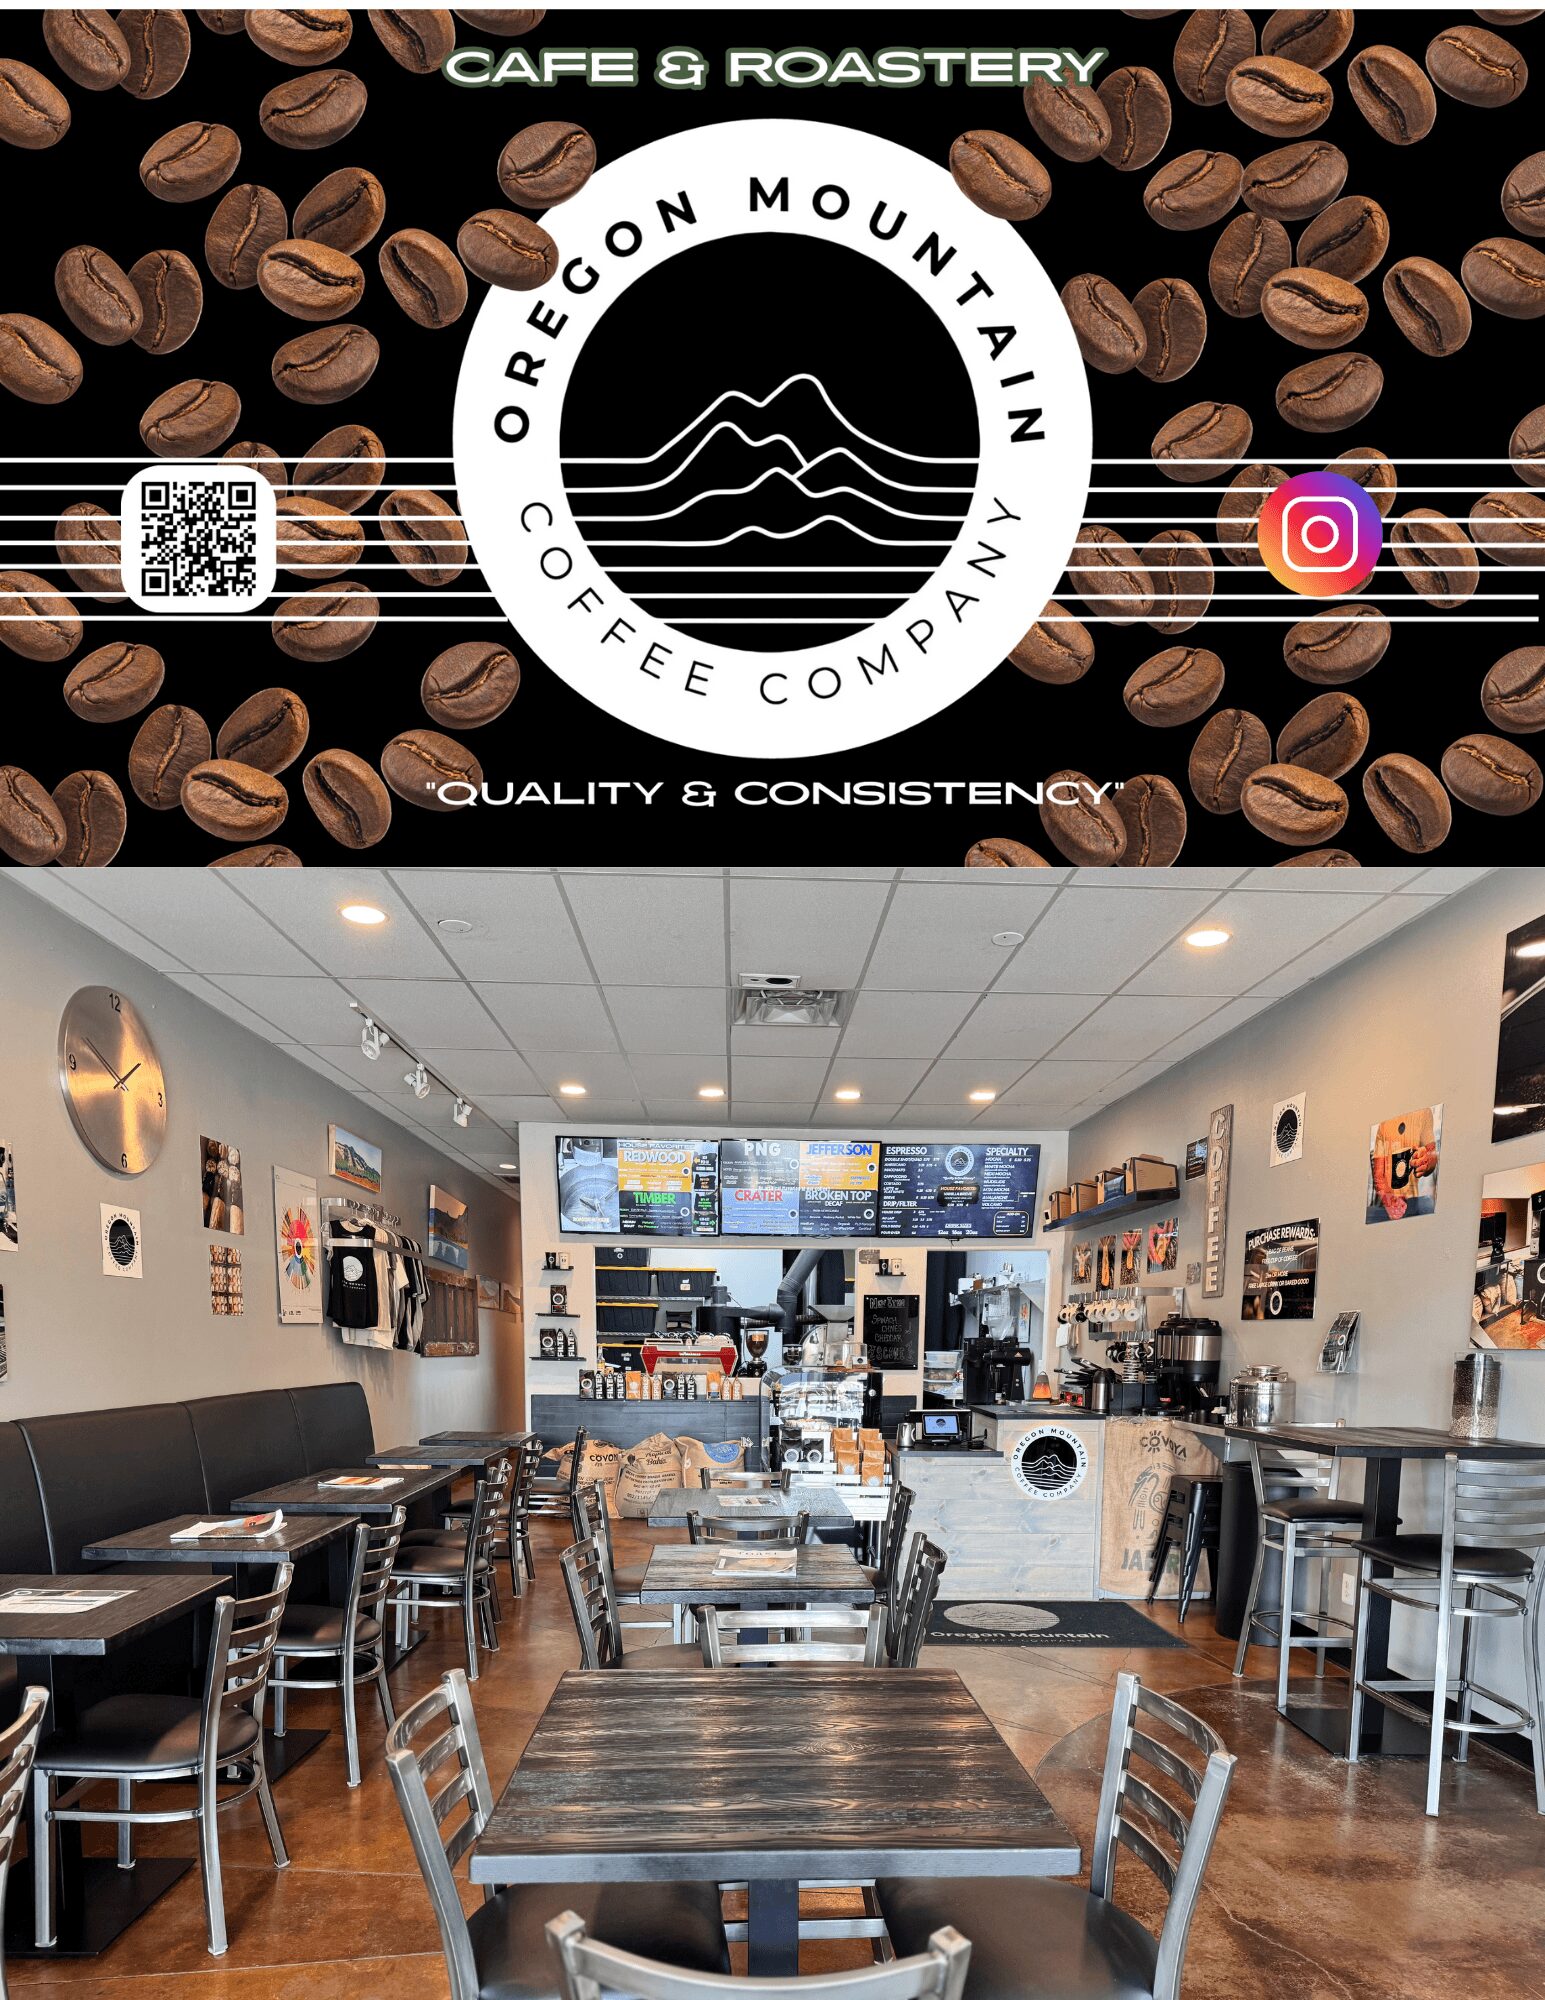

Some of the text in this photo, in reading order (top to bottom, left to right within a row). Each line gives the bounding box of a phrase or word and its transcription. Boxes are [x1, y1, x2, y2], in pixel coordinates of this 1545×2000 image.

[108, 993, 121, 1012] 12
[68, 1054, 77, 1071] 9
[157, 1092, 163, 1107] 3
[744, 1142, 780, 1156] PNG
[806, 1144, 872, 1156] JEFFERSON
[886, 1147, 928, 1155] ESPRESSO
[986, 1148, 1029, 1156] SPECIALTY
[121, 1153, 128, 1169] 6
[624, 1151, 686, 1163] REDWOOD
[633, 1192, 676, 1204] TIMBER
[735, 1189, 783, 1202] CRATER
[805, 1191, 872, 1200] BROKEN TOP
[1205, 1113, 1226, 1292] COFFEE
[1248, 1226, 1316, 1250] PURCHASE REWARDS:
[1013, 1429, 1087, 1467] OREGON MOUNTAIN
[1015, 1467, 1082, 1498] COFFEE COMPANY
[930, 1631, 1006, 1639] Oregon
